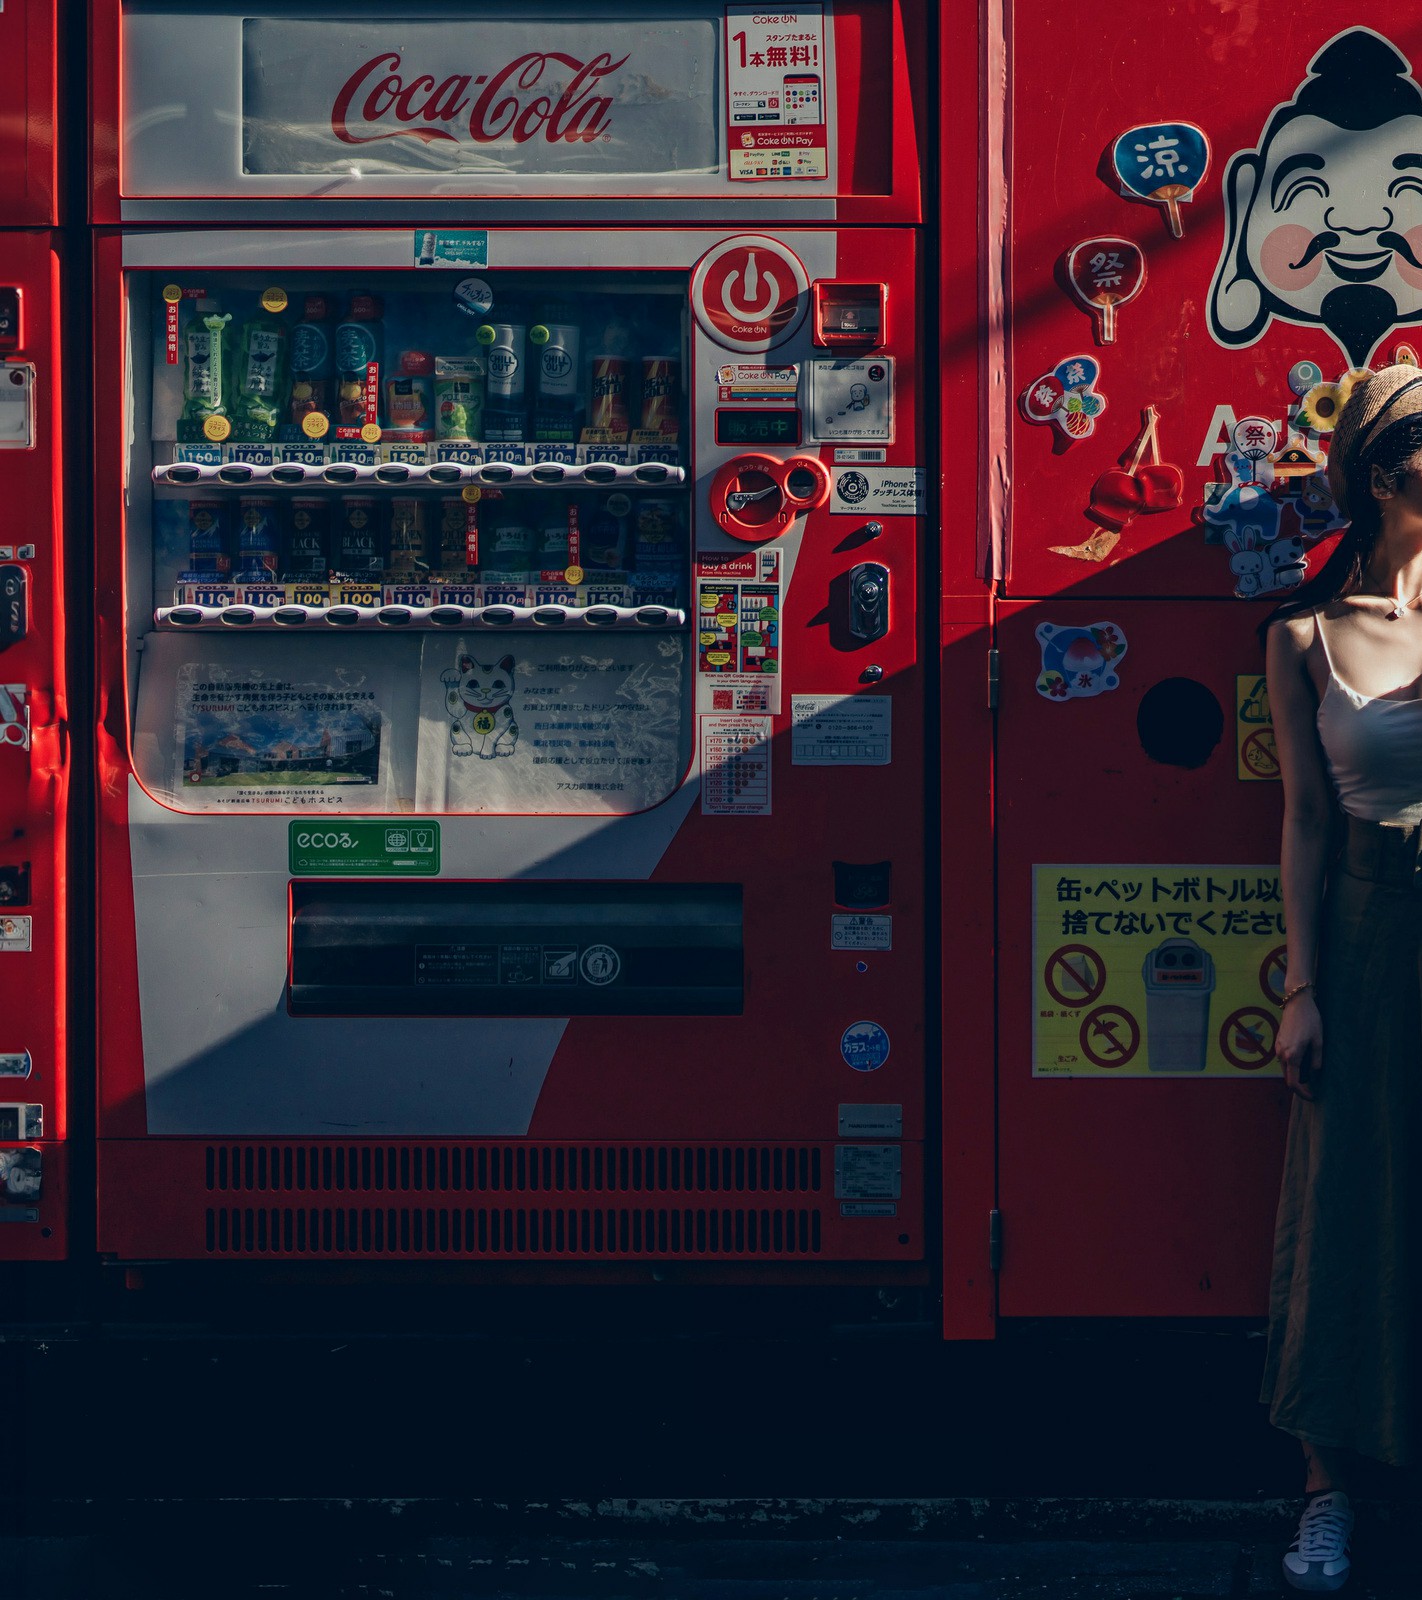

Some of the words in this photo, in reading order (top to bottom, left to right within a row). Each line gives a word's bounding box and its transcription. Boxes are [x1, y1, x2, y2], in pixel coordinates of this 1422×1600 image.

[753, 15, 779, 24] Coke
[781, 14, 797, 23] ON
[766, 34, 817, 42] スタンプたまると
[331, 52, 631, 145] Coca-Cola
[757, 137, 780, 145] Coke
[795, 137, 814, 147] Pay
[1134, 135, 1188, 179] 涼
[1090, 252, 1124, 288] 祭
[168, 305, 176, 361] お手頃価格!
[732, 326, 752, 334] Coke
[490, 354, 514, 364] CHILL
[544, 354, 568, 364] CHILL
[492, 363, 510, 372] OUT
[546, 363, 564, 372] OUT
[738, 372, 759, 380] Coke
[774, 372, 790, 382] Pay
[368, 366, 377, 420] お手頃価格!
[728, 418, 789, 436] 販売中
[1245, 425, 1265, 447] 祭
[468, 506, 476, 562] お手頃価格!
[569, 508, 578, 564] お手頃価格!
[702, 562, 719, 571] buy
[1078, 674, 1093, 688] 氷
[477, 717, 490, 730] 福
[1056, 877, 1284, 903] 缶・ペットボトル以
